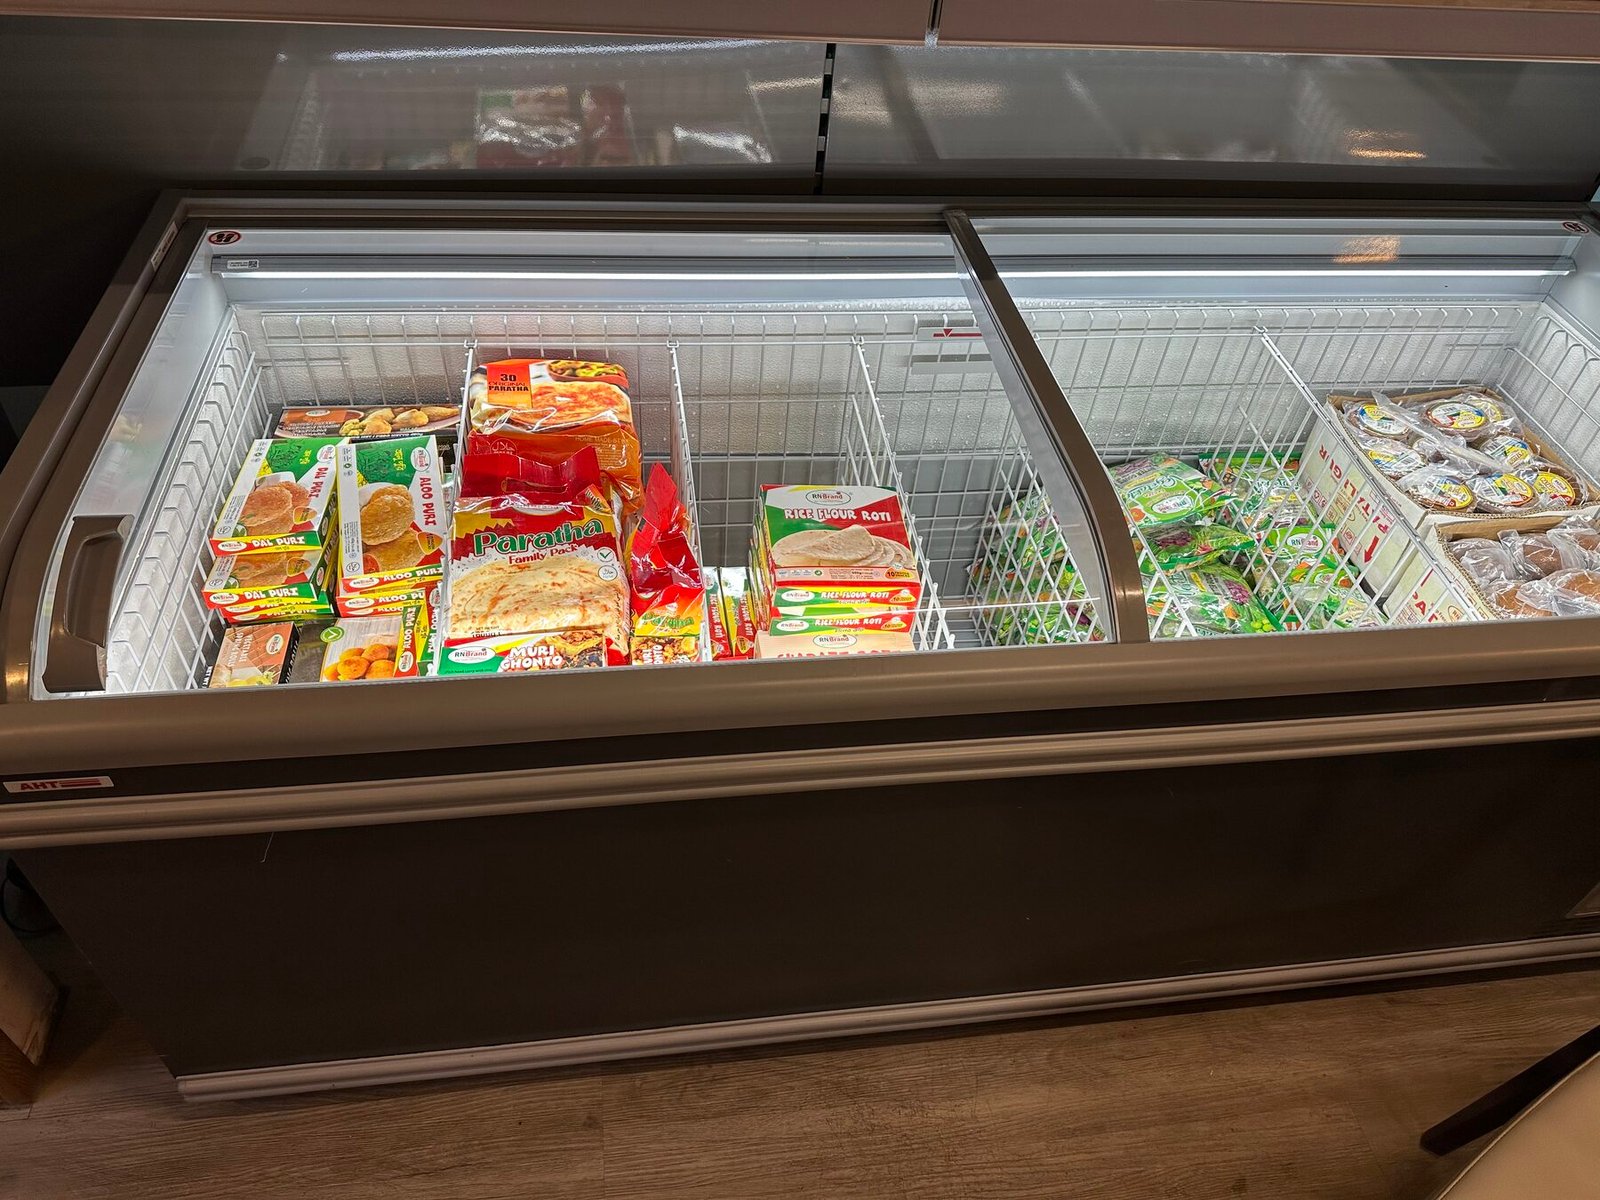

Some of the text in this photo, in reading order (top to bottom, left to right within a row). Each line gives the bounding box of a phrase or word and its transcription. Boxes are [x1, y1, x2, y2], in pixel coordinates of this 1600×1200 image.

[501, 373, 516, 381] 30
[308, 467, 328, 498] DAL PURI
[419, 477, 433, 499] ALOO
[422, 502, 437, 526] PURI
[783, 508, 891, 522] RICE FLOUR ROTI
[251, 536, 306, 548] DAL PURI
[473, 518, 604, 557] Paratha
[508, 544, 578, 564] Family Pack
[383, 571, 413, 581] ALOO
[415, 567, 444, 577] PURI
[244, 587, 299, 600] DAL PURI
[378, 591, 424, 603] ALOO PU
[403, 607, 416, 649] ALOO PURI
[510, 645, 555, 658] MURI
[500, 656, 563, 670] GHONTO
[20, 780, 59, 791] AHT
